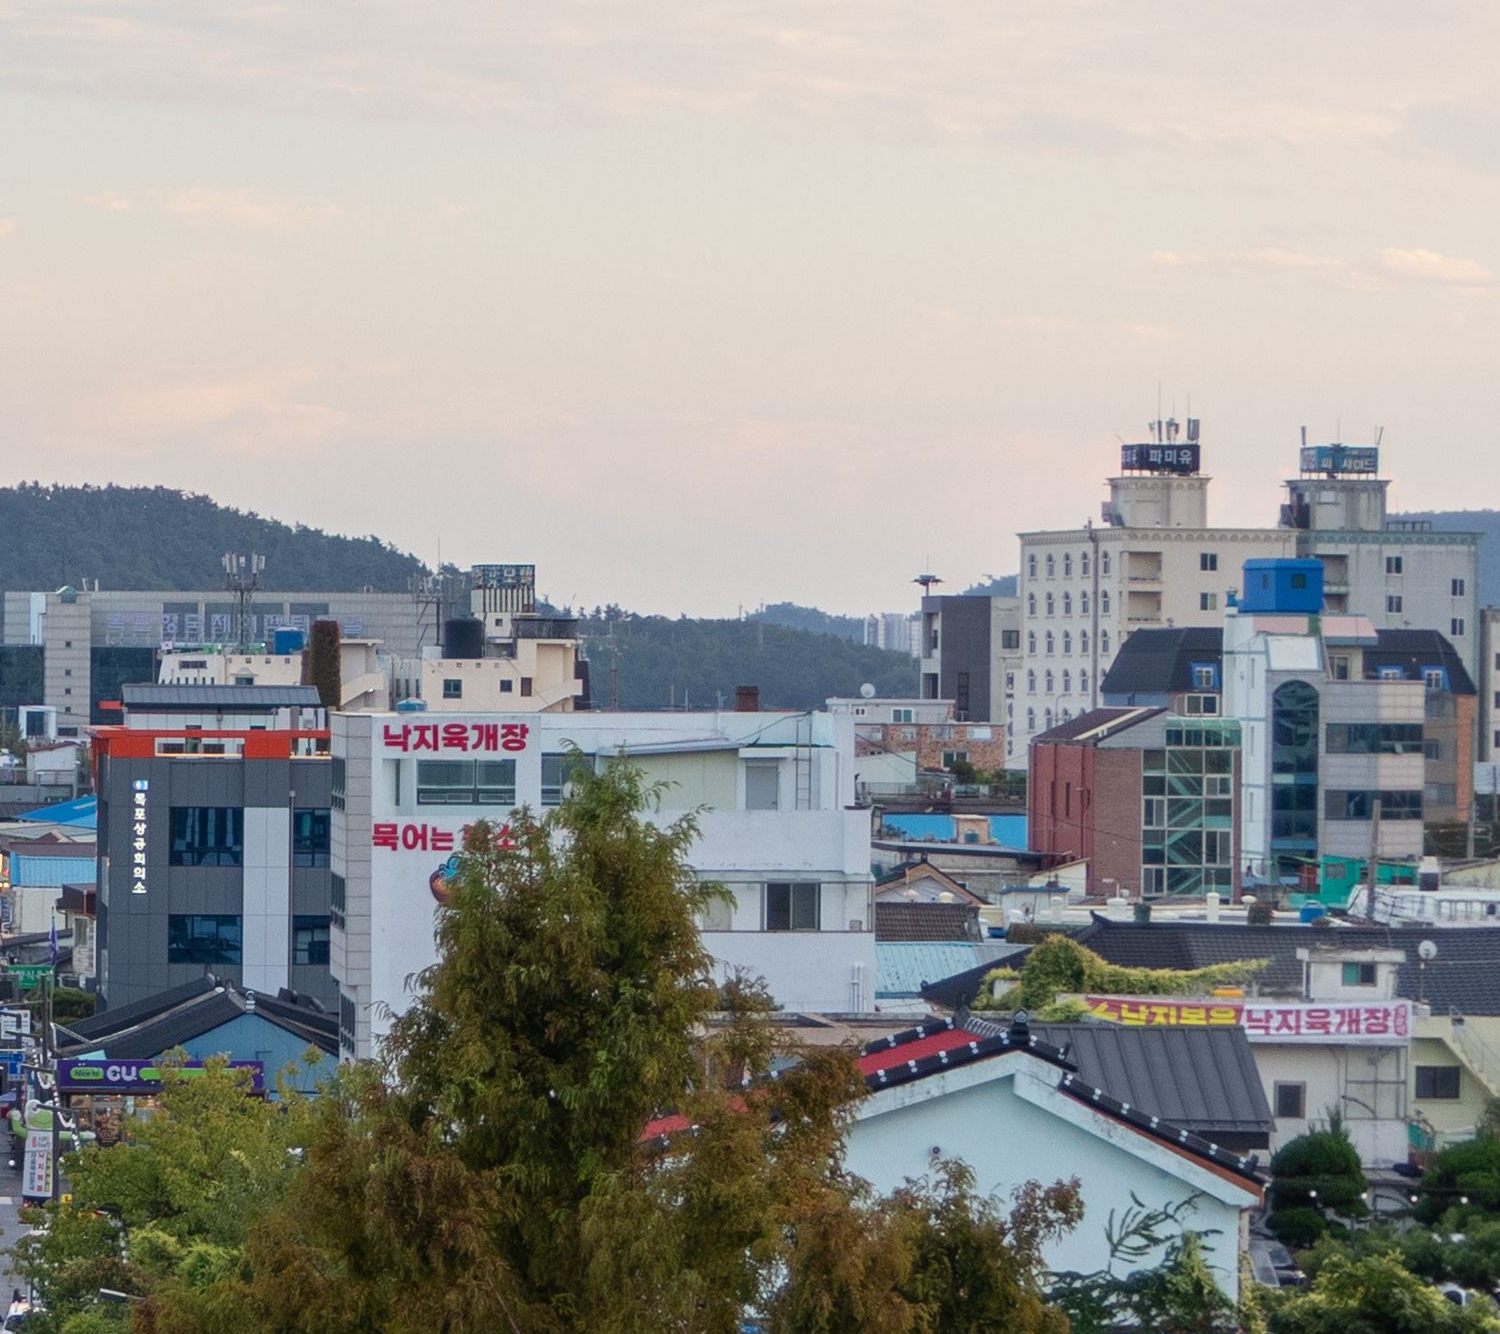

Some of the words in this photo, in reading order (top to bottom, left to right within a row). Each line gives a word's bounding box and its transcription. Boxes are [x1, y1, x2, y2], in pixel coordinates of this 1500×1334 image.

[1149, 450, 1192, 464] 파미유
[384, 723, 529, 752] 낙지육개장
[132, 793, 147, 893] 목포상공회의소
[1248, 1008, 1391, 1035] 낙지육개장
